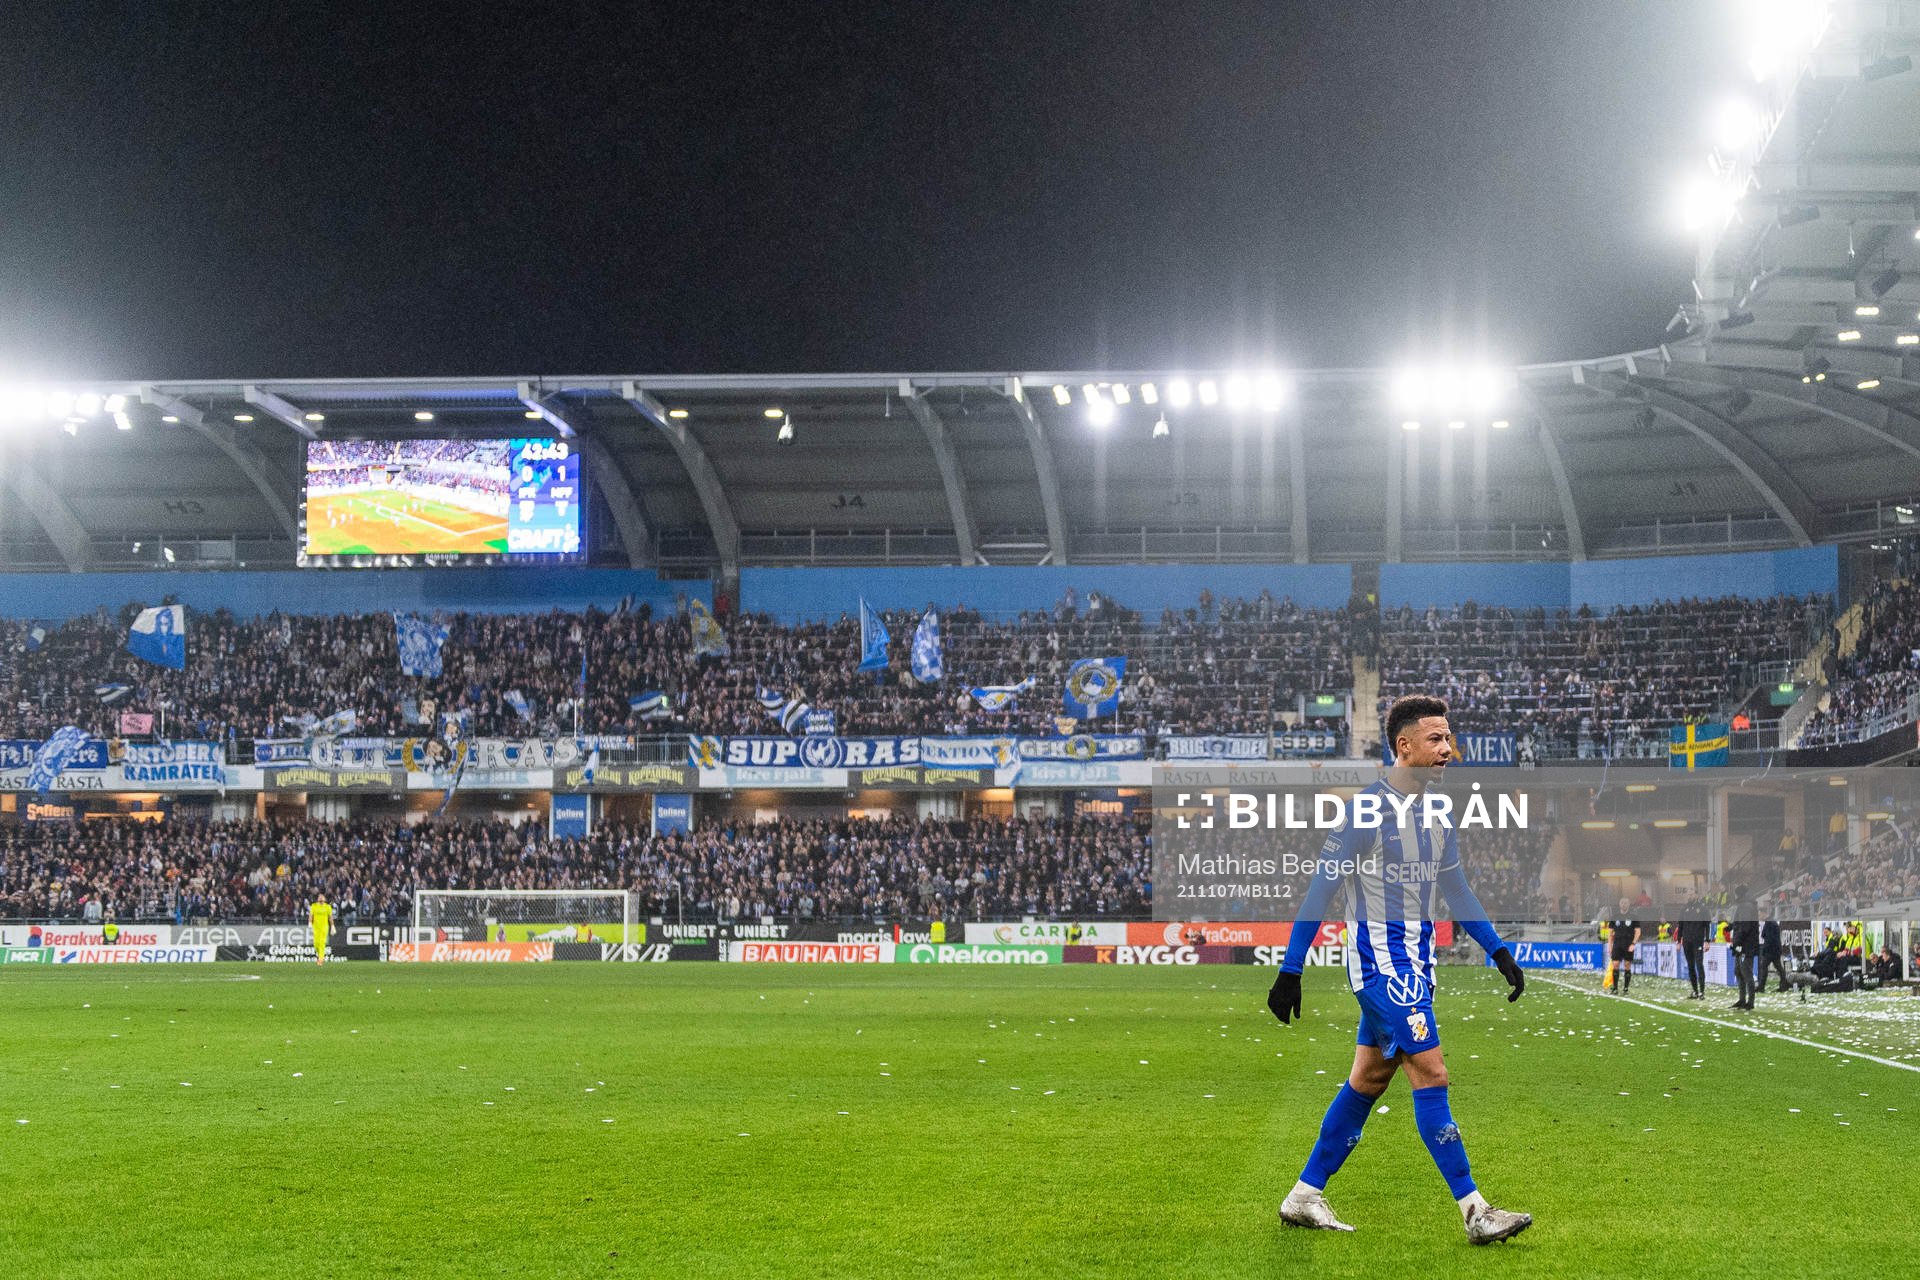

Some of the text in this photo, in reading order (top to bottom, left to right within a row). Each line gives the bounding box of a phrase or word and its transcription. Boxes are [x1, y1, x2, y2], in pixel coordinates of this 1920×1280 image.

[522, 466, 566, 482] 0 1
[729, 740, 920, 766] SUP RAS
[1466, 737, 1513, 762] MEN
[57, 777, 104, 789] RASTA
[1164, 771, 1361, 784] RASTA RASTA RASTA
[663, 925, 789, 939] UNIBET UNIBET
[837, 928, 892, 944] morris
[11, 949, 207, 963] MCR INTERSPORT
[431, 943, 512, 962] Renova
[744, 945, 880, 963] BAUHAUS
[938, 946, 1049, 964] Rekomo
[1533, 949, 1594, 963] KONTAKT
